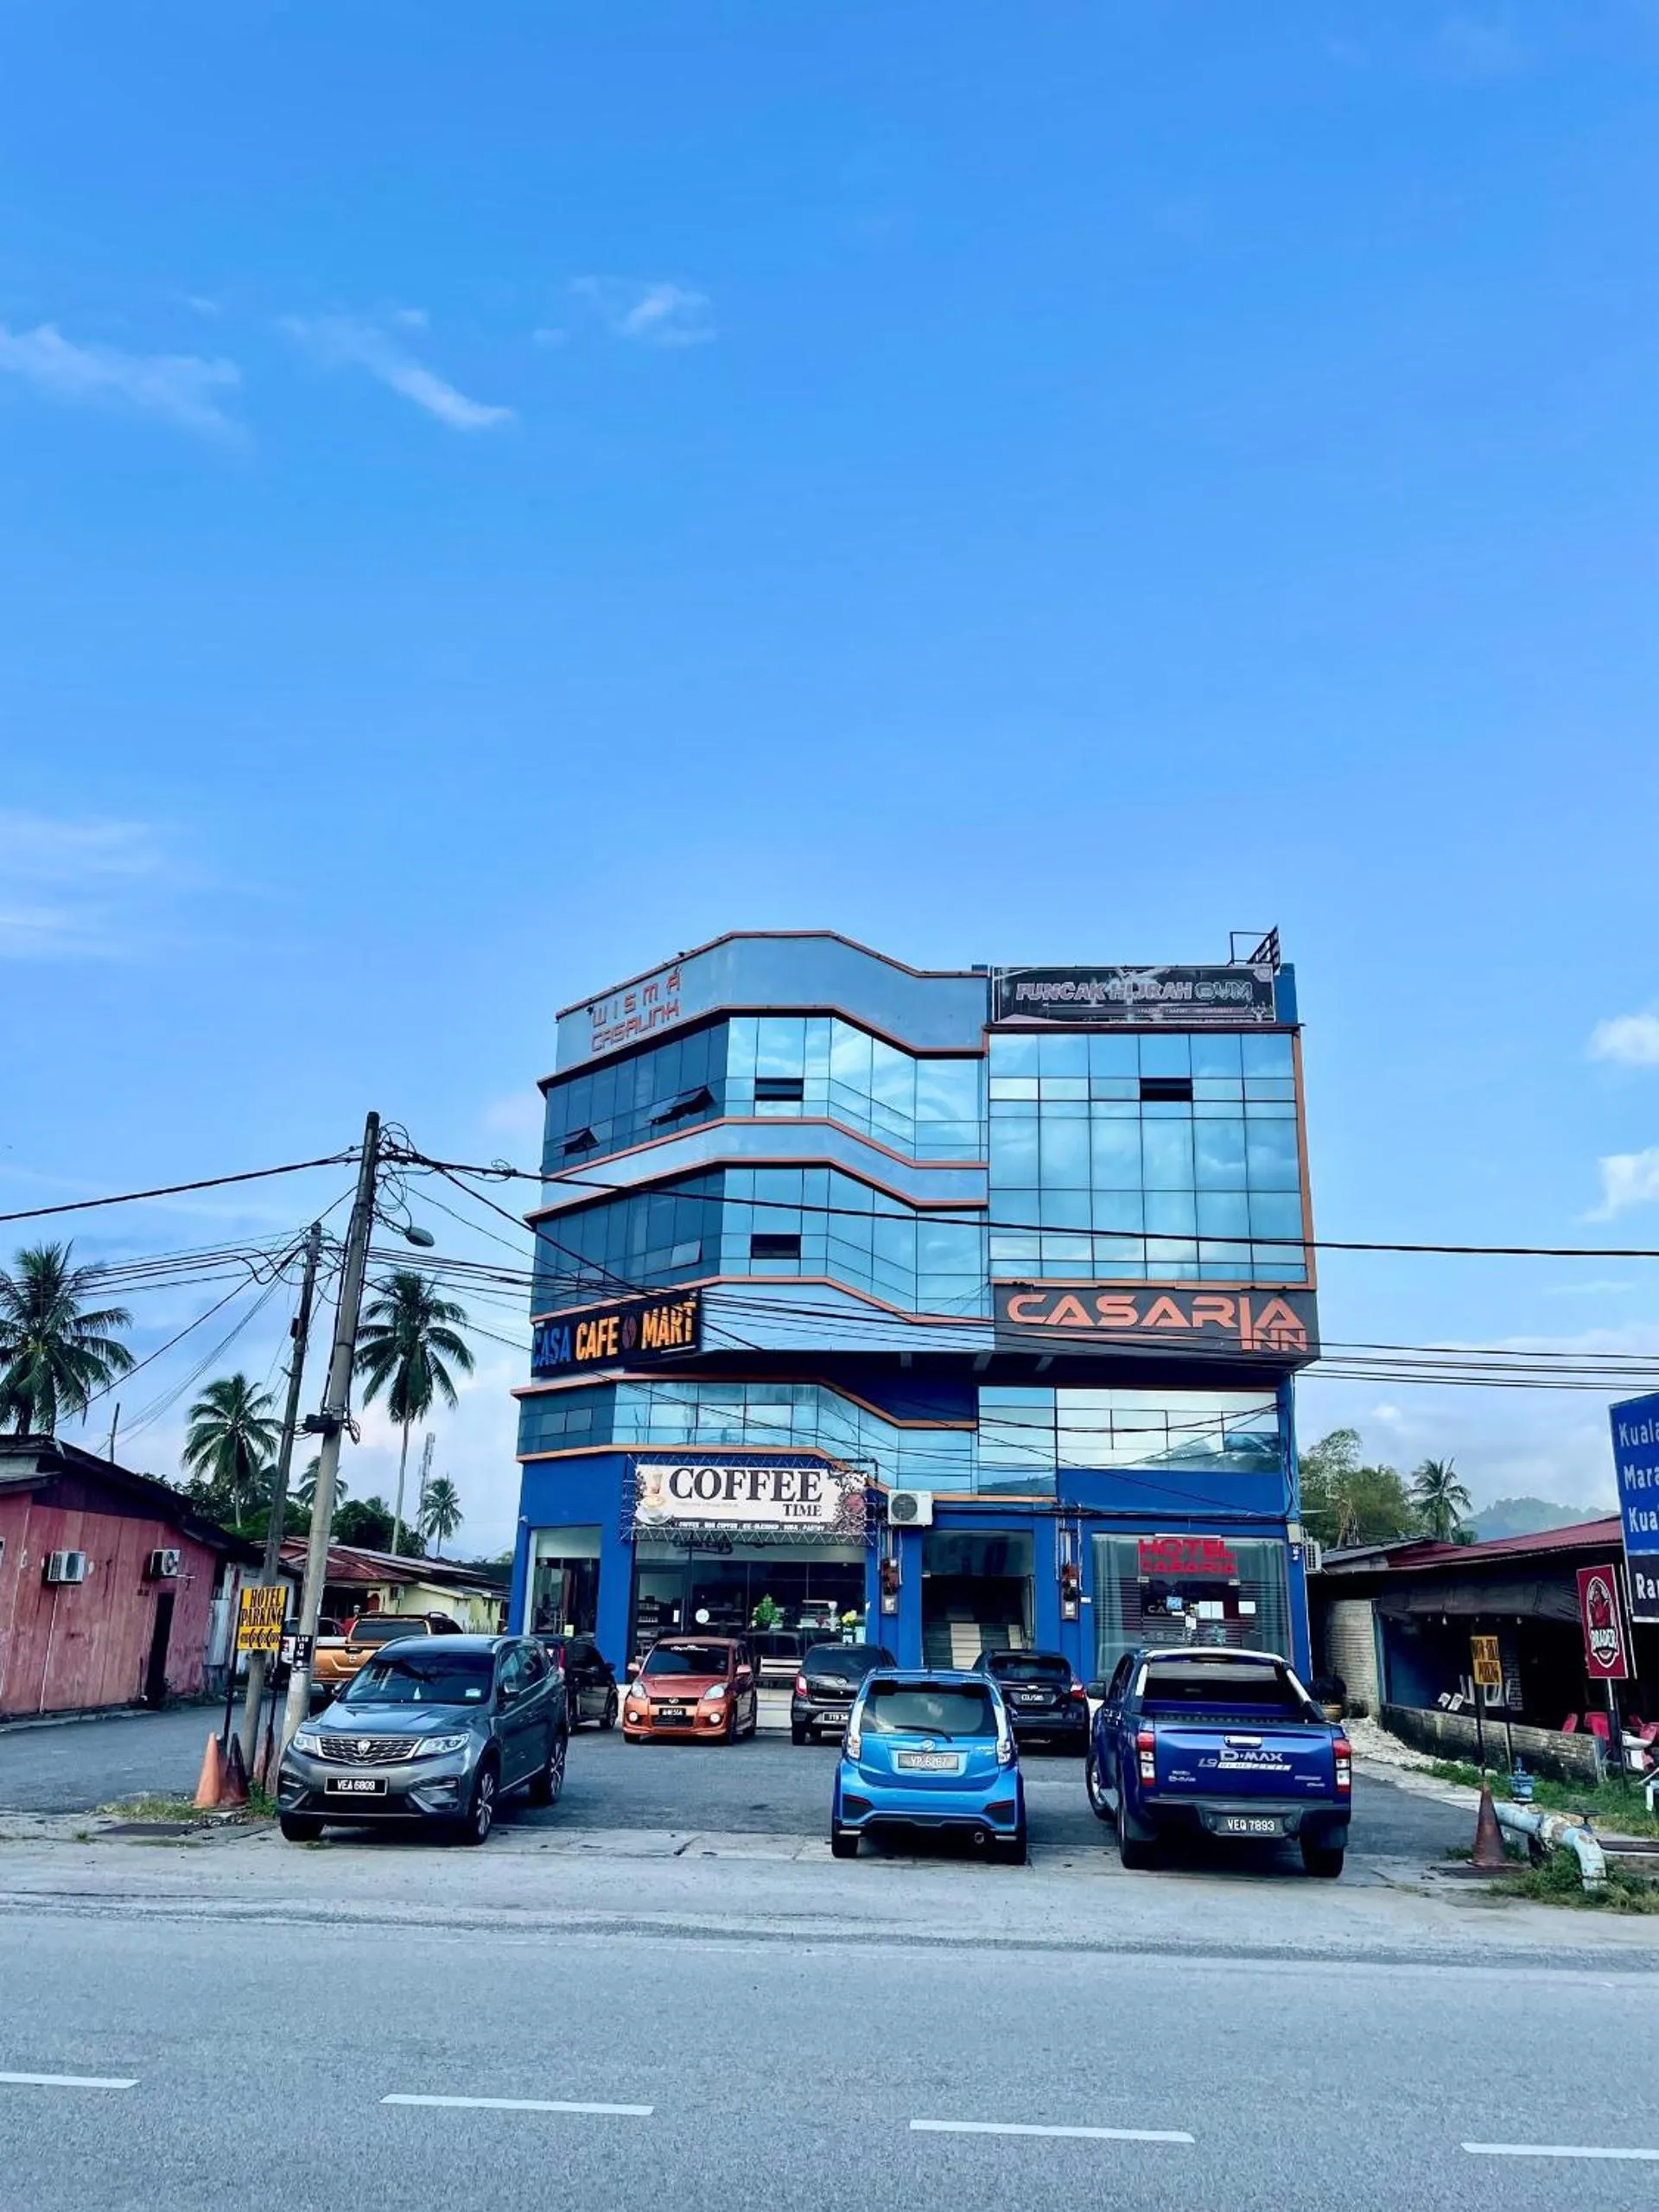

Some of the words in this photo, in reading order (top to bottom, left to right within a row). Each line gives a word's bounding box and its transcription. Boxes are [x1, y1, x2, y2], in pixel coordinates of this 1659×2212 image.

[1007, 1294, 1306, 1336] CASARIA
[533, 1325, 571, 1367] CASA
[575, 1316, 620, 1361] CAFE
[641, 1301, 696, 1350] MART
[669, 1467, 823, 1502] COFFEE
[783, 1503, 822, 1517] TIME
[1628, 1504, 1659, 1533] Kua
[1139, 1538, 1235, 1558] HOTEL
[251, 1588, 281, 1607] HOTEL
[1636, 1573, 1659, 1599] Ra
[241, 1605, 283, 1626] PARKING
[337, 1779, 353, 1790] VEA
